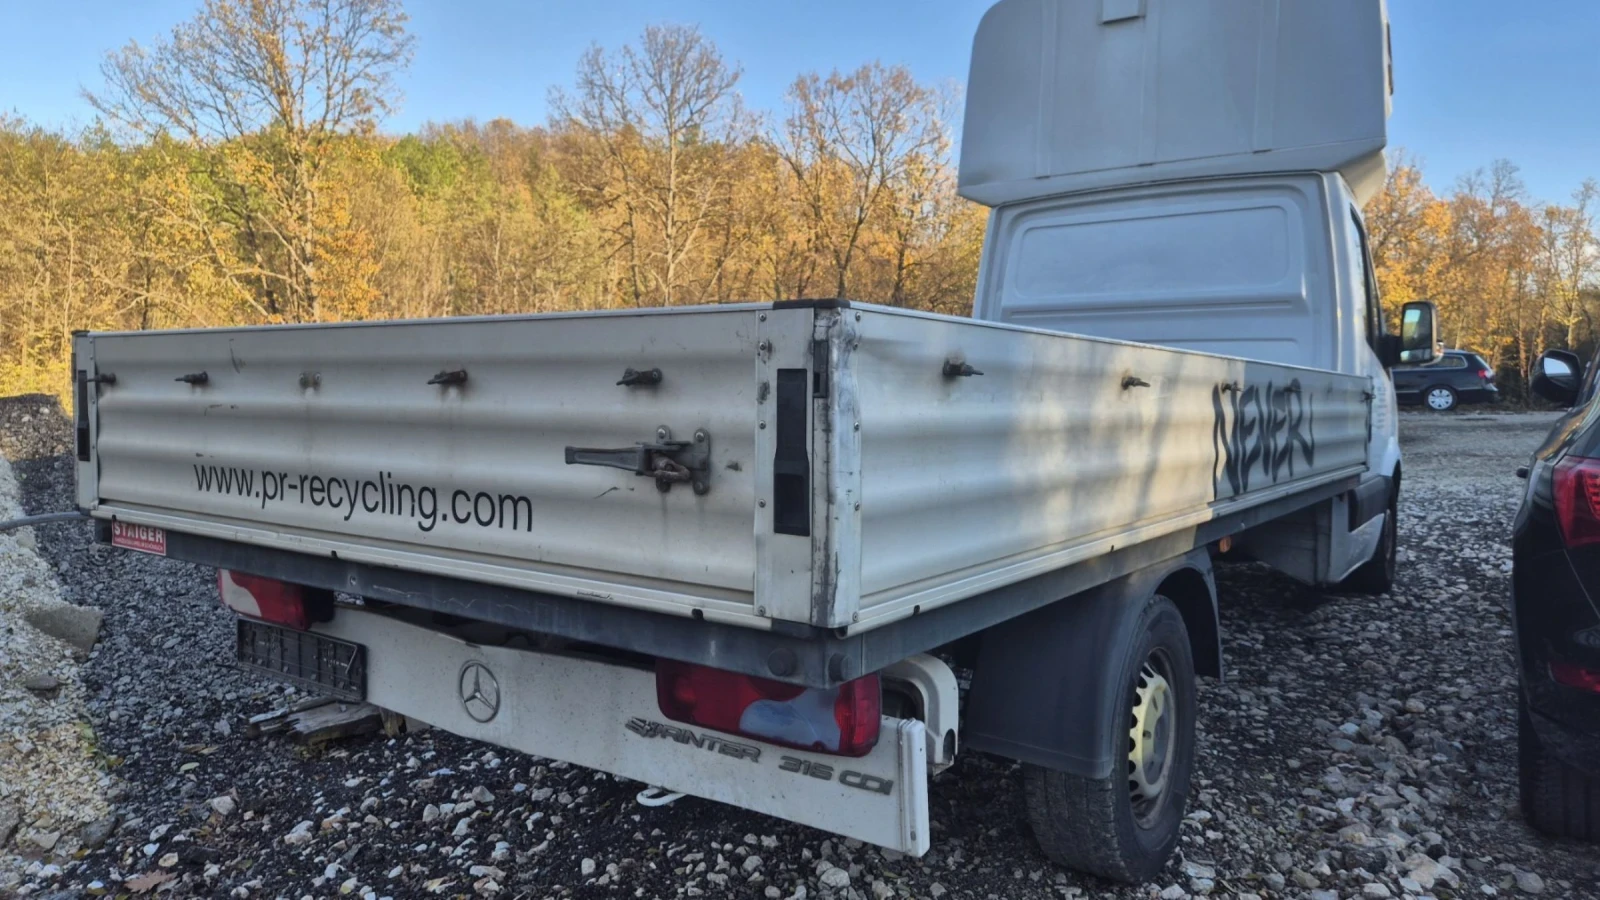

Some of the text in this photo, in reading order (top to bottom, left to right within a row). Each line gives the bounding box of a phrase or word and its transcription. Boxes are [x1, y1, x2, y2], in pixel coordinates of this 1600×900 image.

[193, 464, 533, 532] www.pr-recycling.com
[114, 521, 164, 544] STAIGER
[624, 716, 894, 796] SPRINTER 316 CDI
